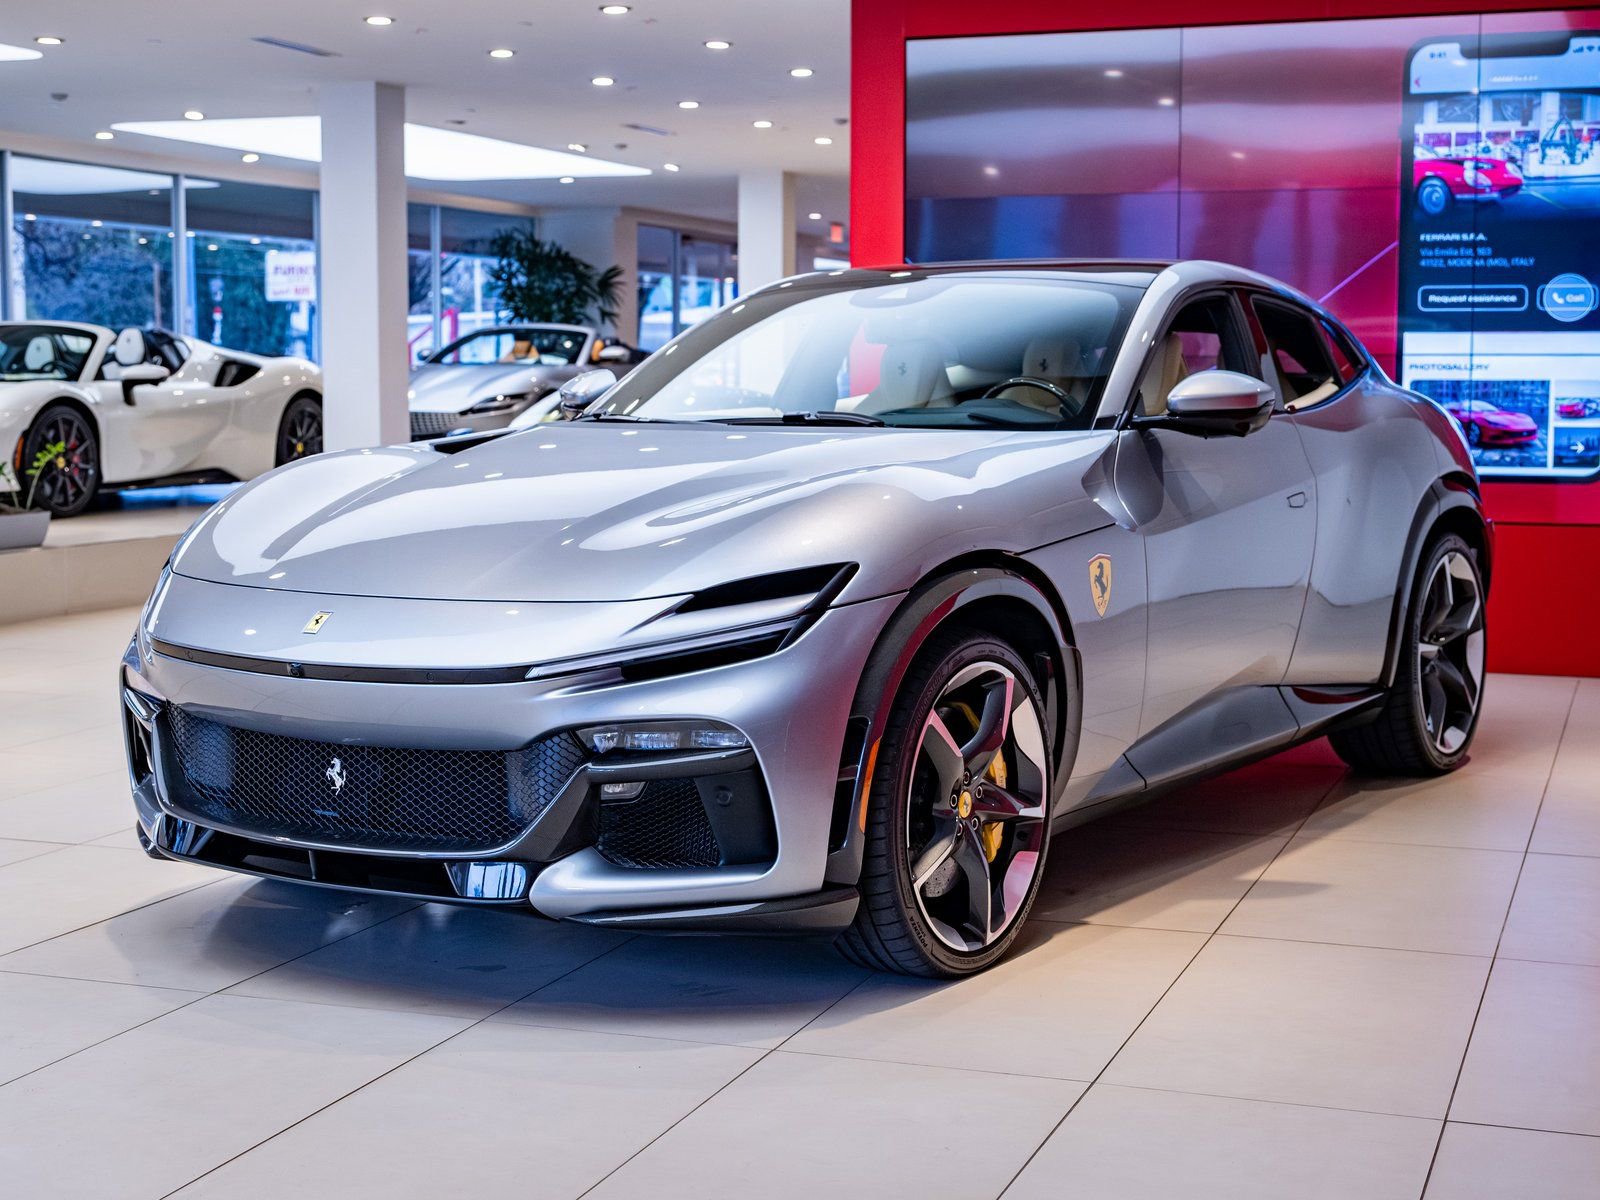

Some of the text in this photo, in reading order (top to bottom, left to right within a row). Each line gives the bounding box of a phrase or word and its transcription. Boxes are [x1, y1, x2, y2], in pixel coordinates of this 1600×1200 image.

[1420, 233, 1460, 241] FERRARI
[1419, 247, 1433, 256] Via
[1434, 247, 1458, 256] Emilia
[1511, 256, 1535, 267] ITALY
[1428, 293, 1517, 303] Request assistance
[1566, 293, 1584, 302] Call
[910, 916, 928, 948] POTENZA
